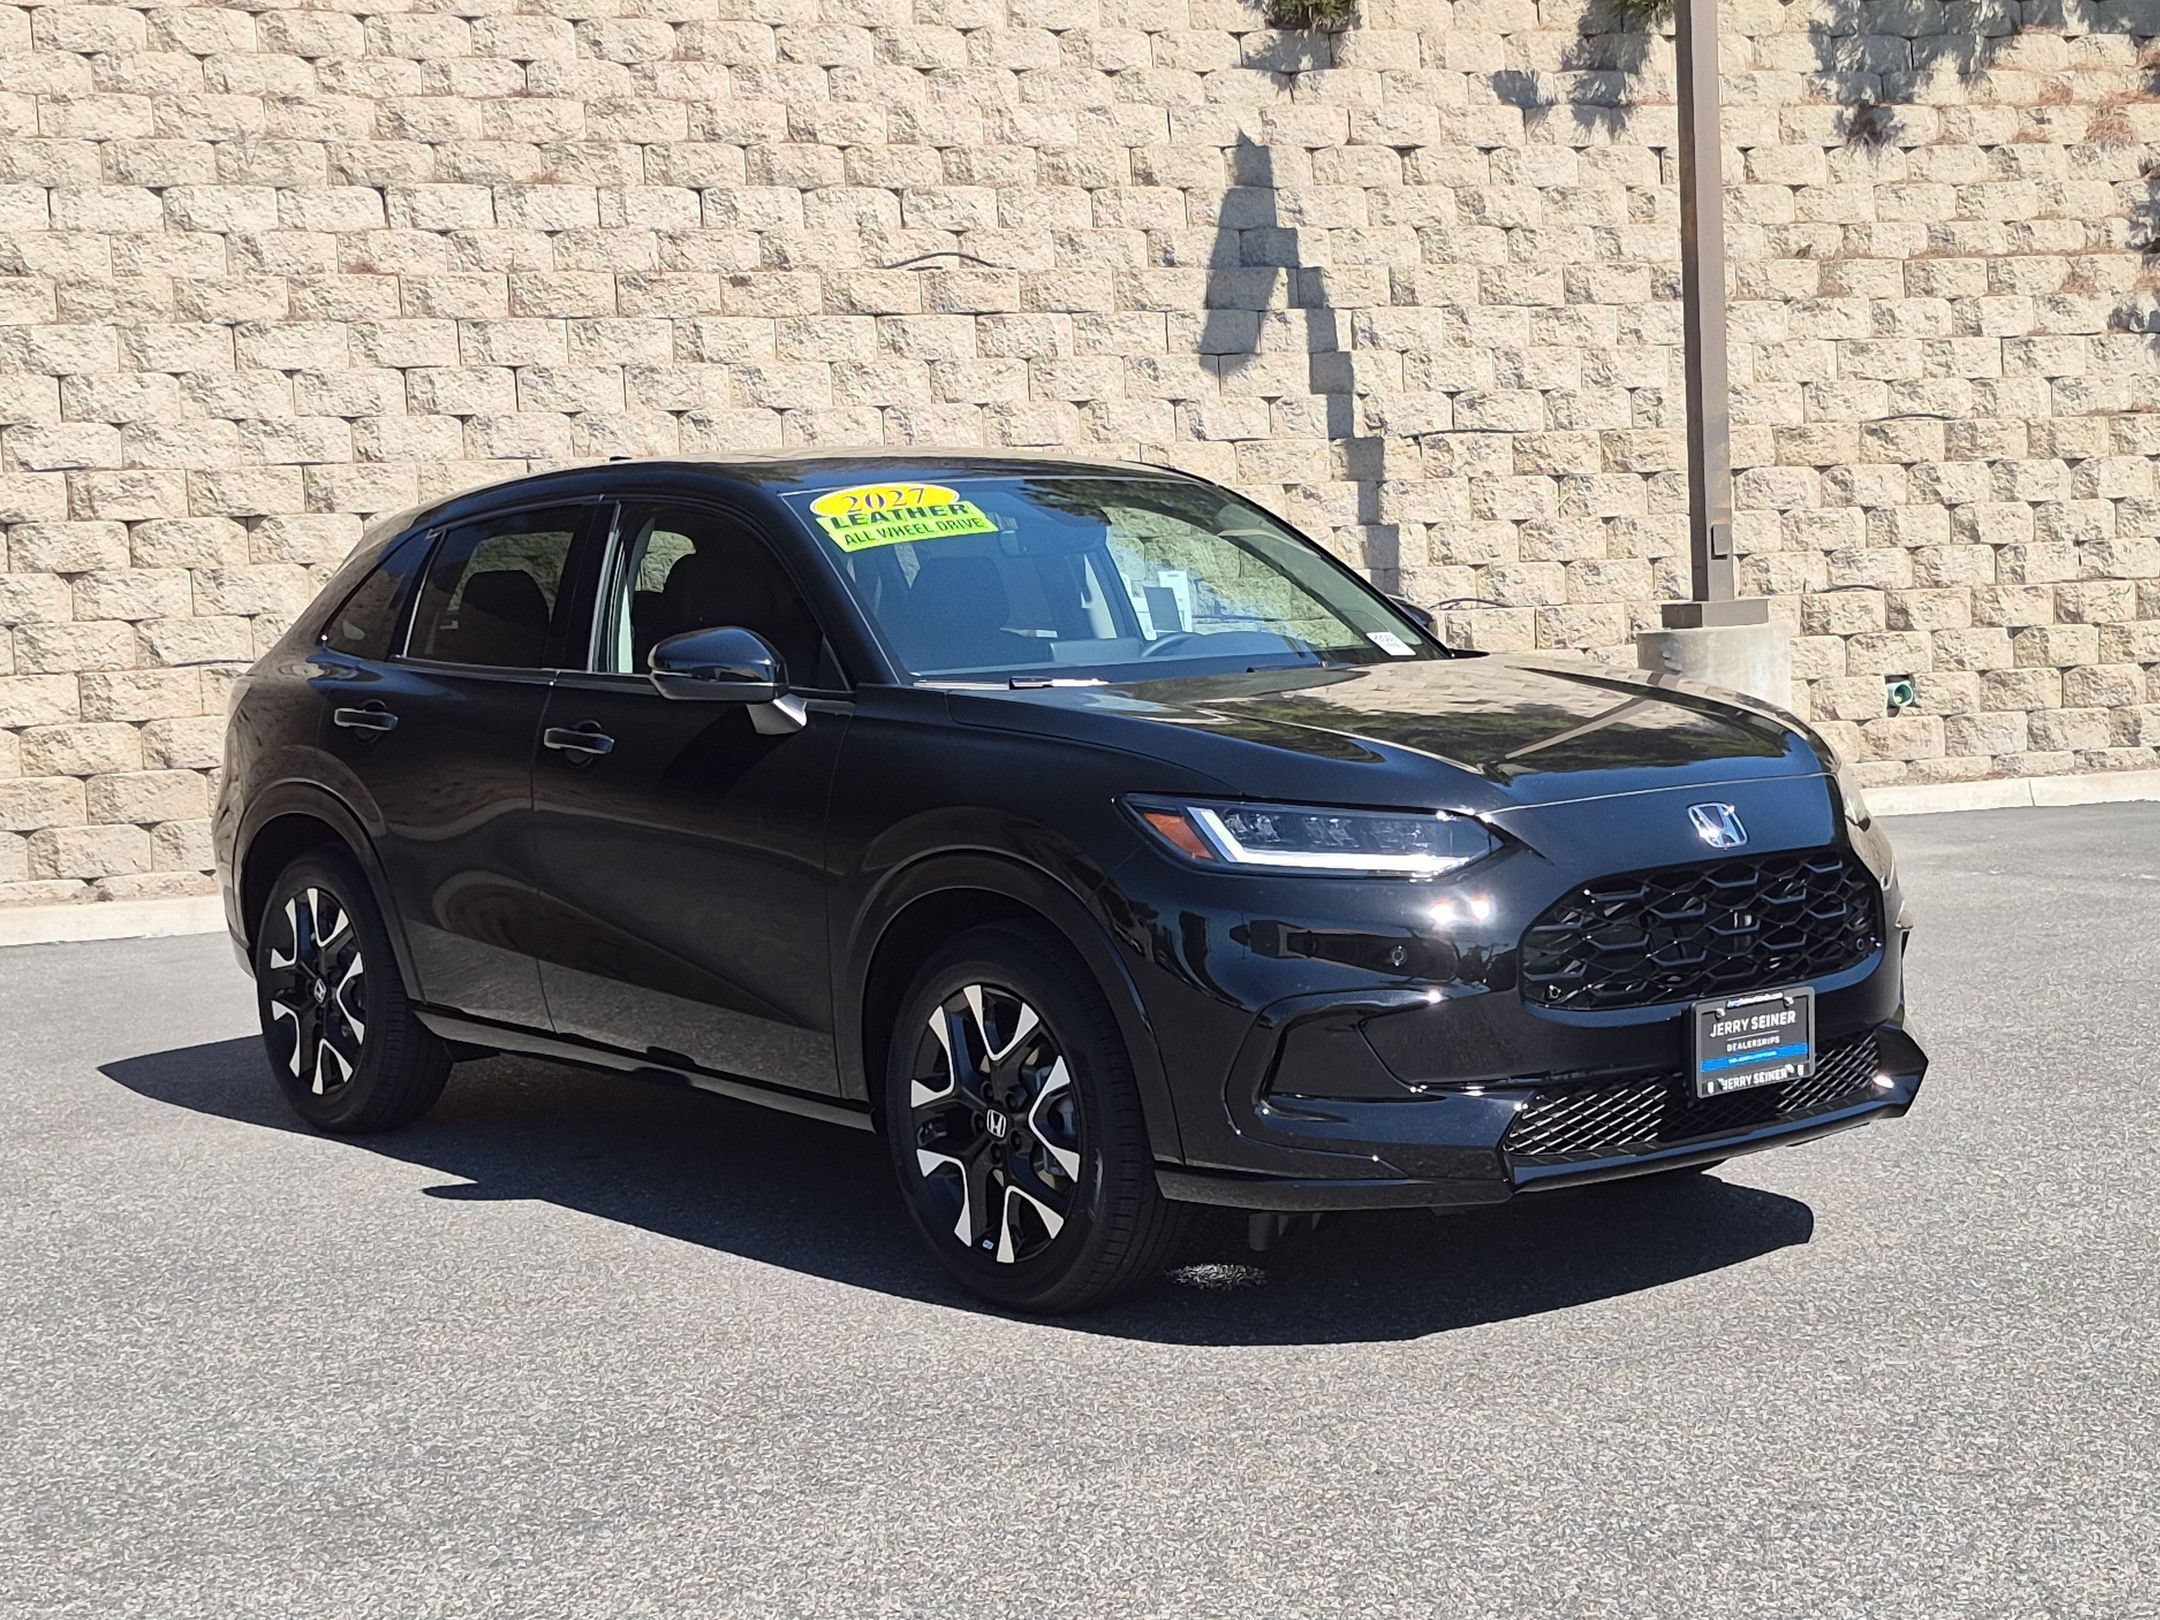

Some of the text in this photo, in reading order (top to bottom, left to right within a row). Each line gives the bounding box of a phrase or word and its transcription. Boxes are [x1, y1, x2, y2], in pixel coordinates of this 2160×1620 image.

[843, 488, 925, 513] 2027
[830, 503, 967, 529] LEATHER
[844, 517, 984, 546] ALL WHEEL DRIVE
[1710, 1010, 1796, 1038] JERRY SEINER
[1726, 1036, 1780, 1052] DEALERSHIPS
[1722, 1068, 1787, 1090] JERRY SEINER
